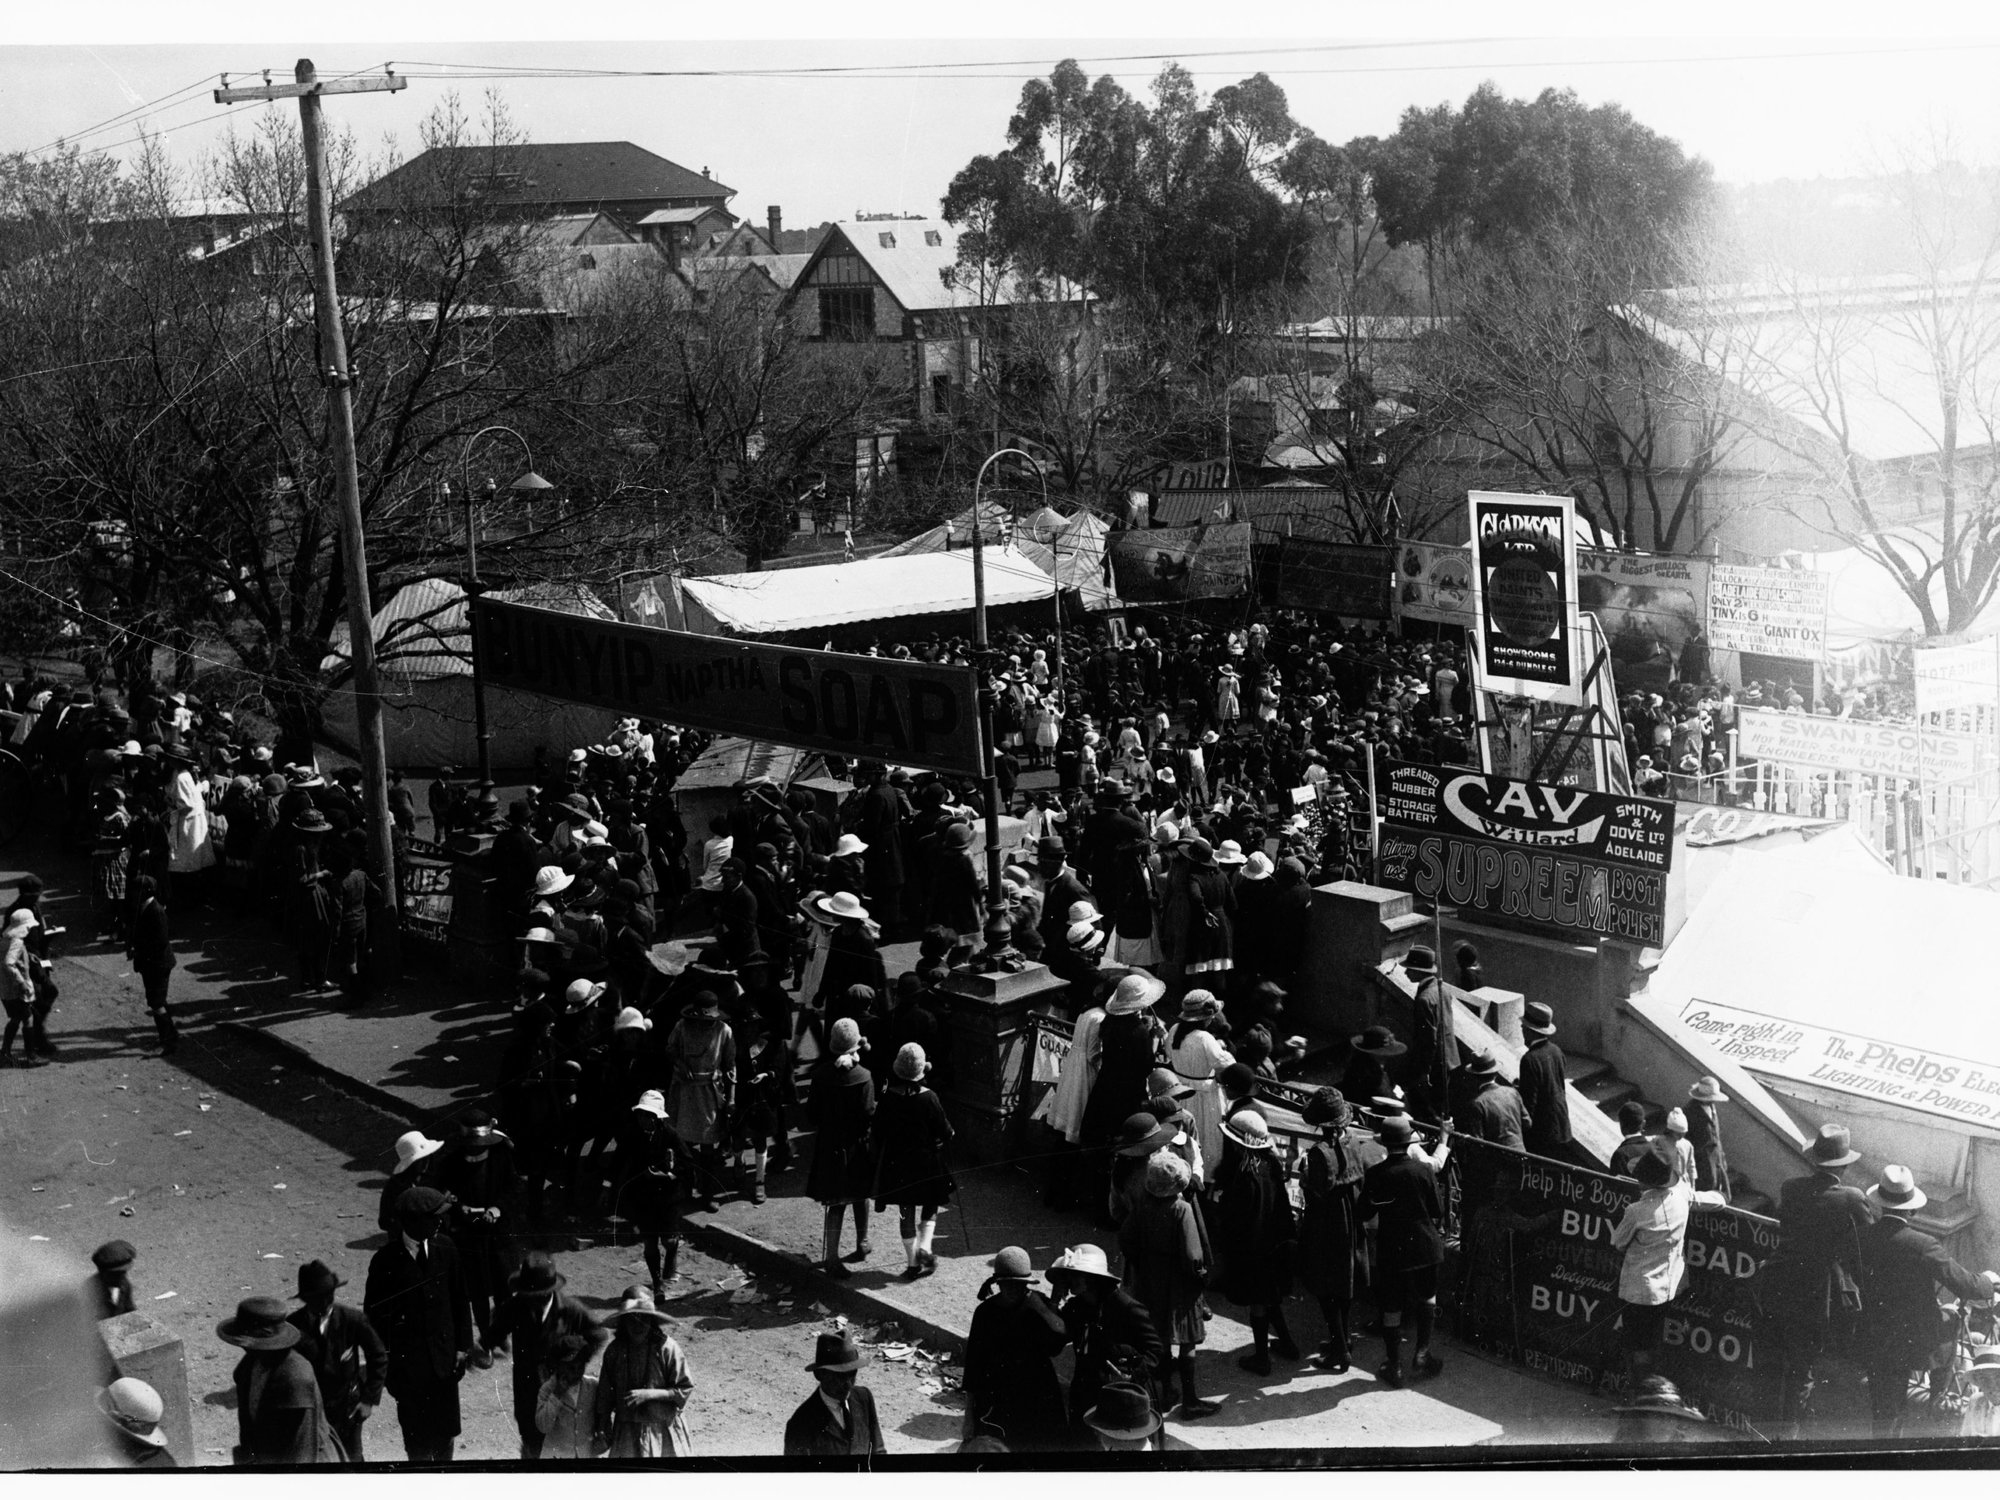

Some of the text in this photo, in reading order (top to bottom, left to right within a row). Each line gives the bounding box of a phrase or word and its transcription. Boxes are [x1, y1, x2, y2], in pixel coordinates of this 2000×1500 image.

[1577, 552, 1618, 574] NY
[1620, 561, 1688, 576] BIGGEST BULLOCK
[1711, 573, 1742, 586] BULLOCK
[1711, 594, 1732, 607] ONLY
[1734, 598, 1743, 609] 2
[1747, 609, 1759, 622] 6
[1764, 624, 1800, 640] GIANT
[1801, 628, 1821, 642] OX
[1493, 646, 1556, 662] SHOWROOMS
[485, 613, 959, 753] BUNYIP NAPTHA SOAP
[1780, 719, 1857, 744] SWAN
[1878, 730, 1960, 756] SONS
[1390, 767, 1440, 788] THREADED
[1391, 782, 1436, 798] RUBBER
[1387, 808, 1438, 824] BATTERY
[1388, 798, 1437, 813] STORAGE
[1615, 803, 1663, 825] SMITH
[1479, 817, 1580, 846] Willard
[1609, 825, 1646, 843] DOVE
[1631, 817, 1644, 829] &
[1605, 840, 1665, 865] ADELAIDE
[1415, 837, 1610, 931] SUPREEM
[1611, 869, 1661, 907] BOOT
[1608, 904, 1662, 942] POLISH
[1684, 1010, 1736, 1034] Come
[1718, 1037, 1800, 1061] Inspect
[1823, 1036, 1854, 1061] The
[1857, 1042, 1960, 1084] Phelps
[1808, 1063, 1991, 1118] LIGHTING & POWER
[1519, 1162, 1632, 1214] Help the Boys
[1747, 1219, 1780, 1250] You
[1687, 1239, 1766, 1279] BAD
[1550, 1263, 1617, 1293] Designed
[1530, 1284, 1601, 1323] BUY
[1663, 1317, 1754, 1370] BOO
